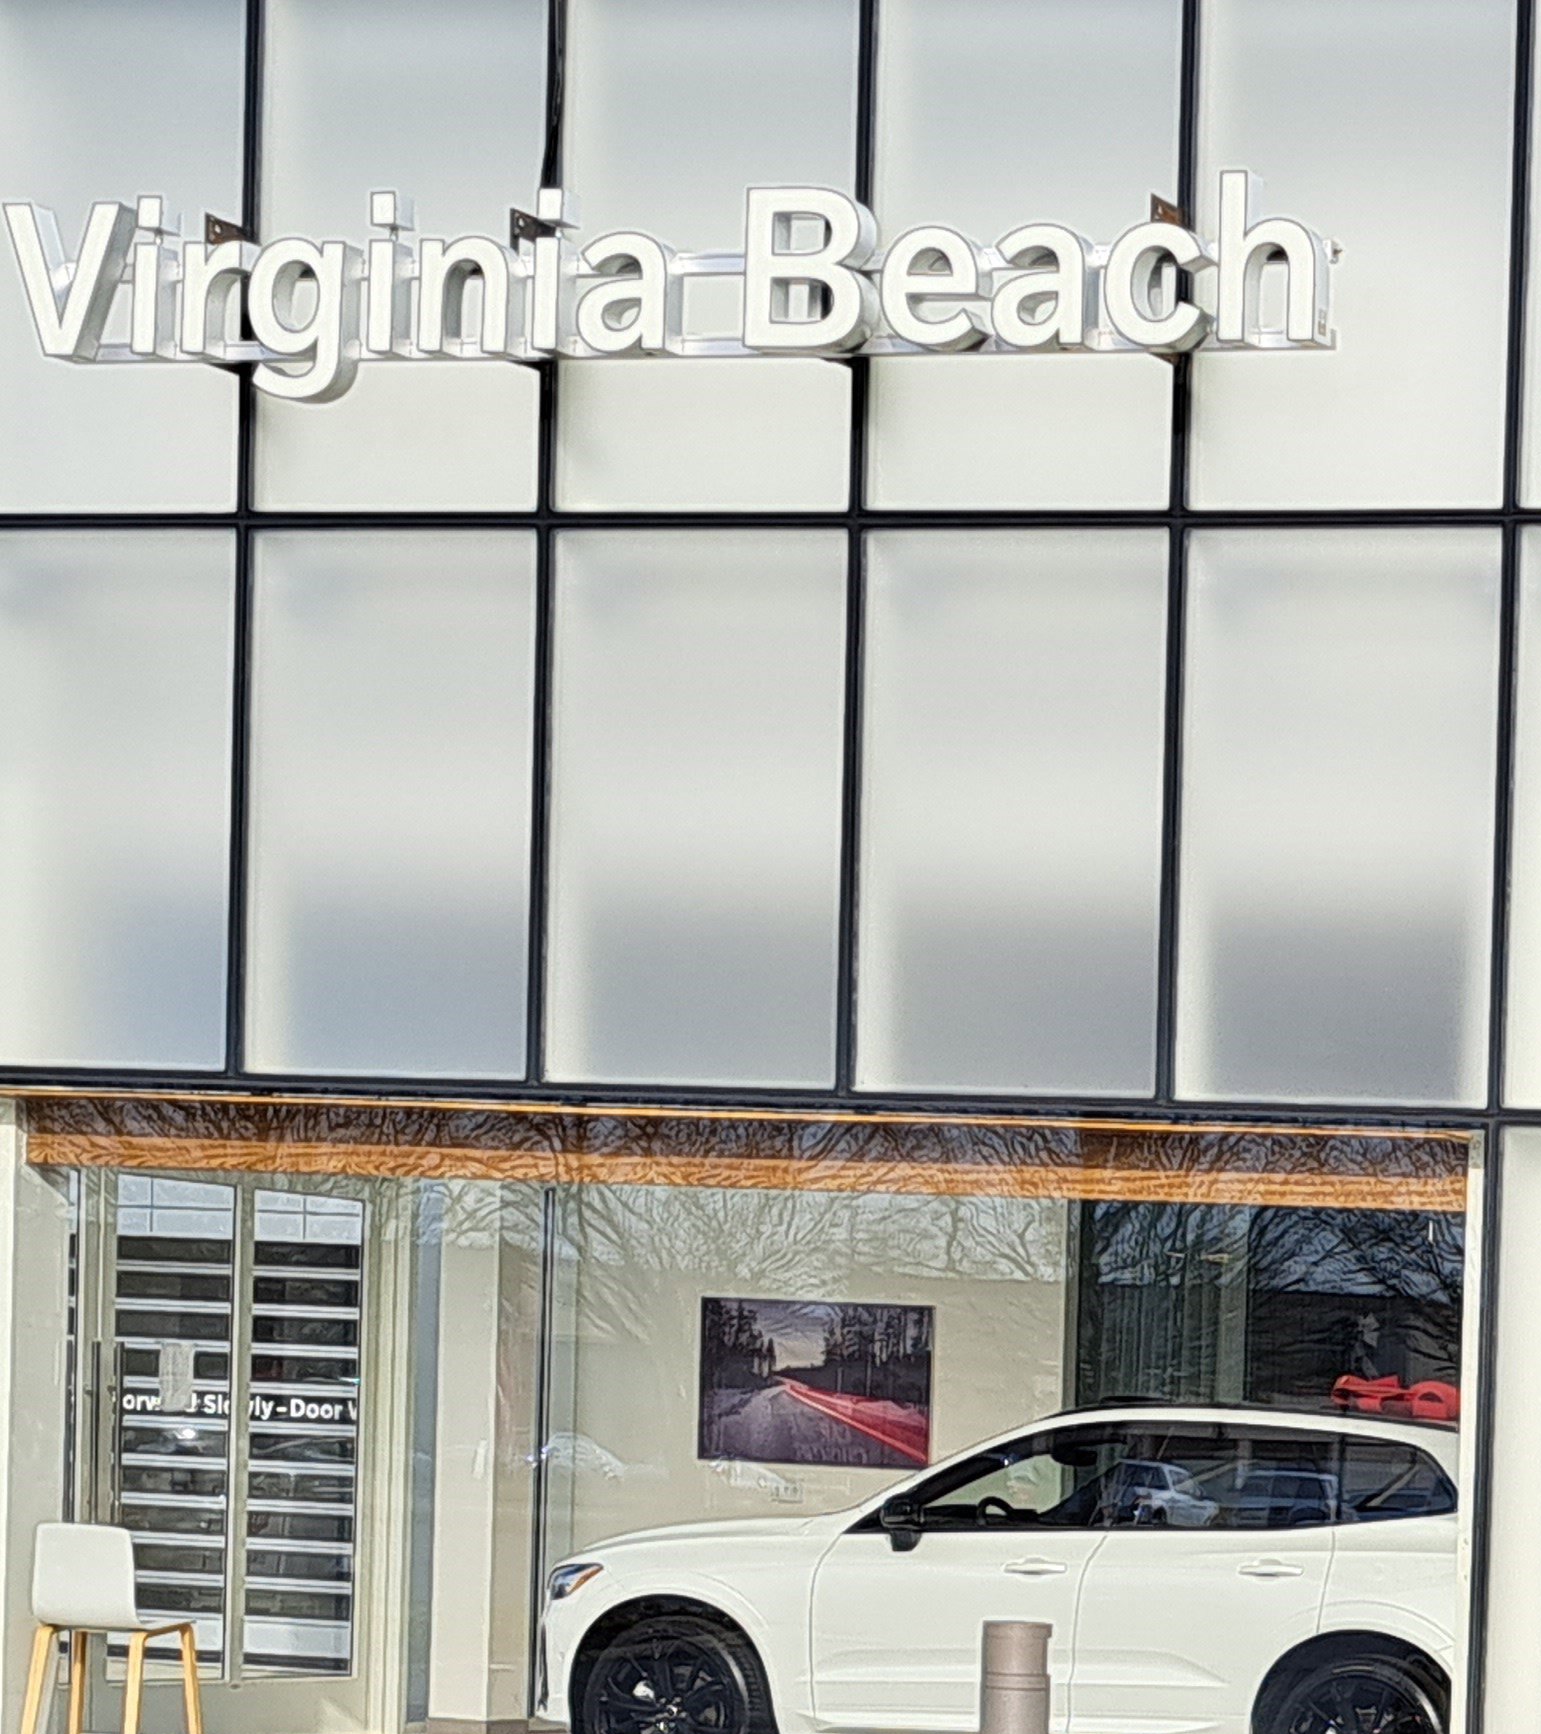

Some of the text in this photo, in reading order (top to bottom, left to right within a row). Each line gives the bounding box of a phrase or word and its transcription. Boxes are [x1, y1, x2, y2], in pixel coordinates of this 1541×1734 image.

[3, 169, 1320, 400] Virginia Beach
[290, 1398, 343, 1420] Door
